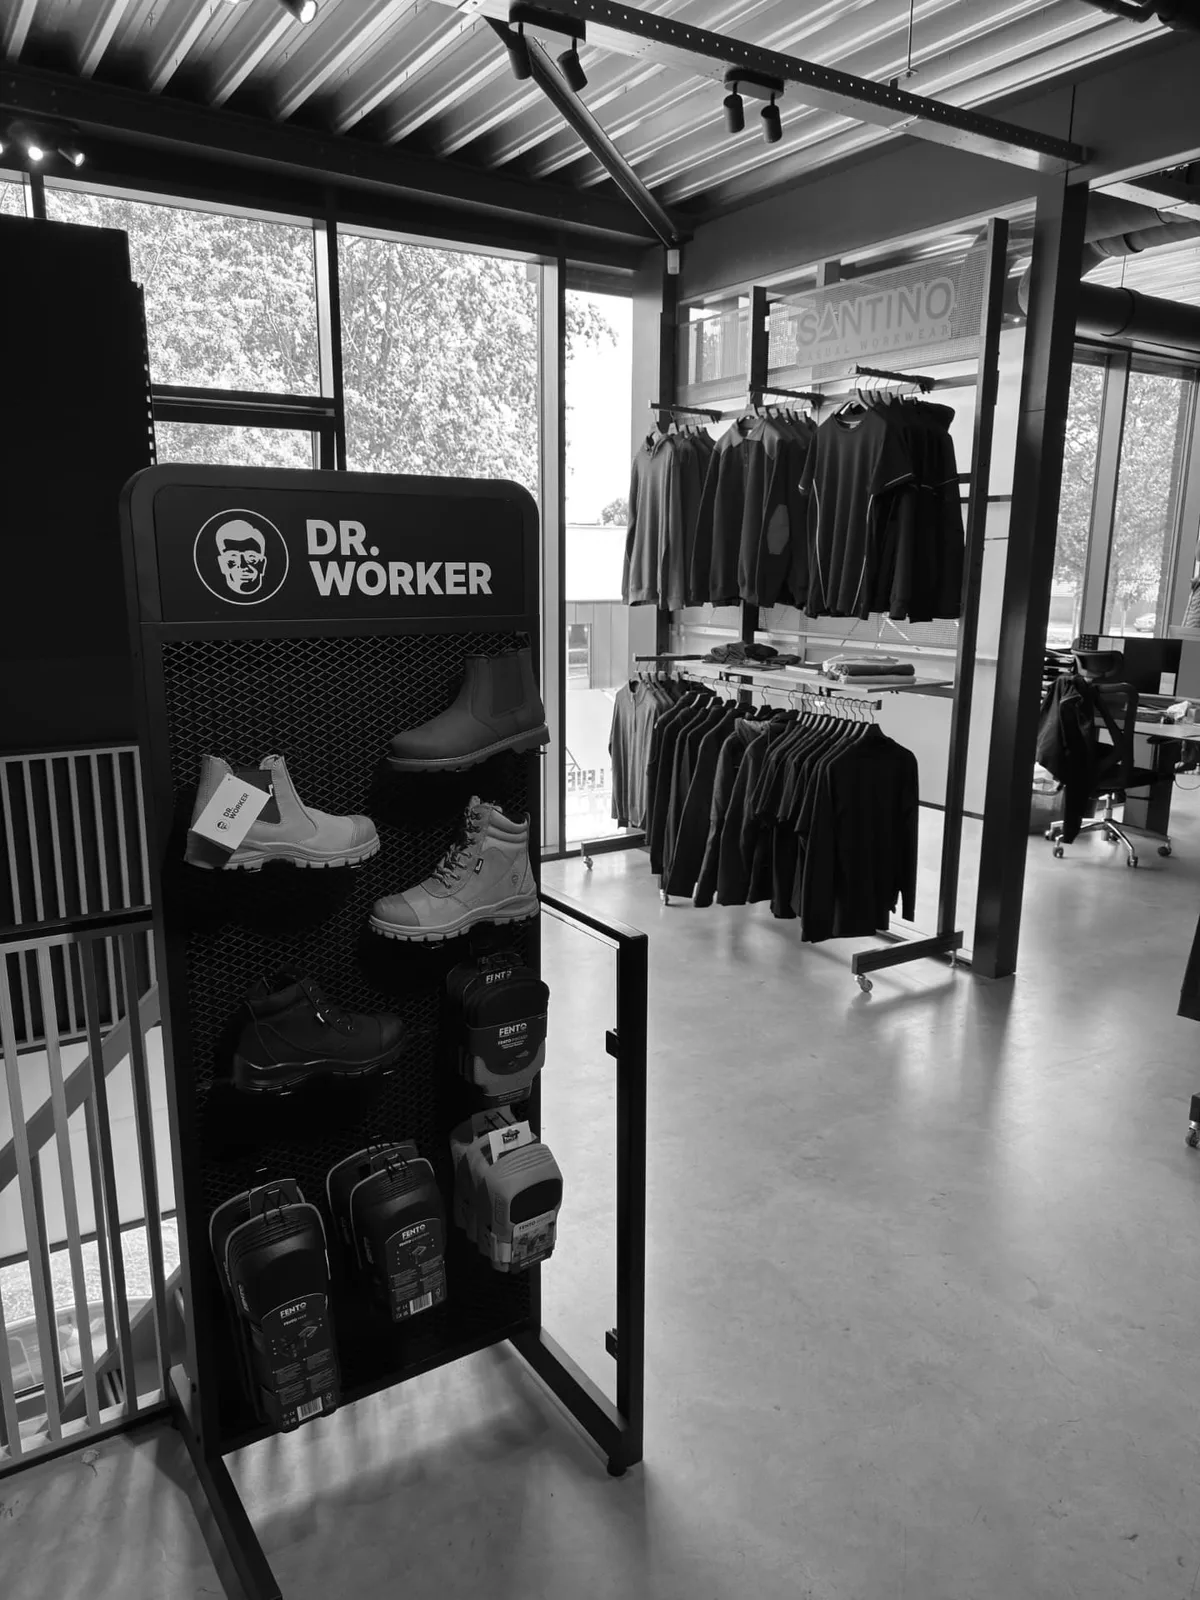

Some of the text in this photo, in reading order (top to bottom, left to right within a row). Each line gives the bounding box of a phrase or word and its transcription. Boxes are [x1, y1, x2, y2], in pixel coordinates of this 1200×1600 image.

[799, 282, 952, 346] SANTINO
[860, 324, 949, 351] WORKWEAR
[306, 519, 380, 557] DR.
[308, 561, 493, 596] WORKER
[228, 793, 250, 819] WORKER
[499, 1023, 527, 1036] FENTO
[402, 1224, 426, 1241] FENTO
[280, 1302, 307, 1318] FENTO
